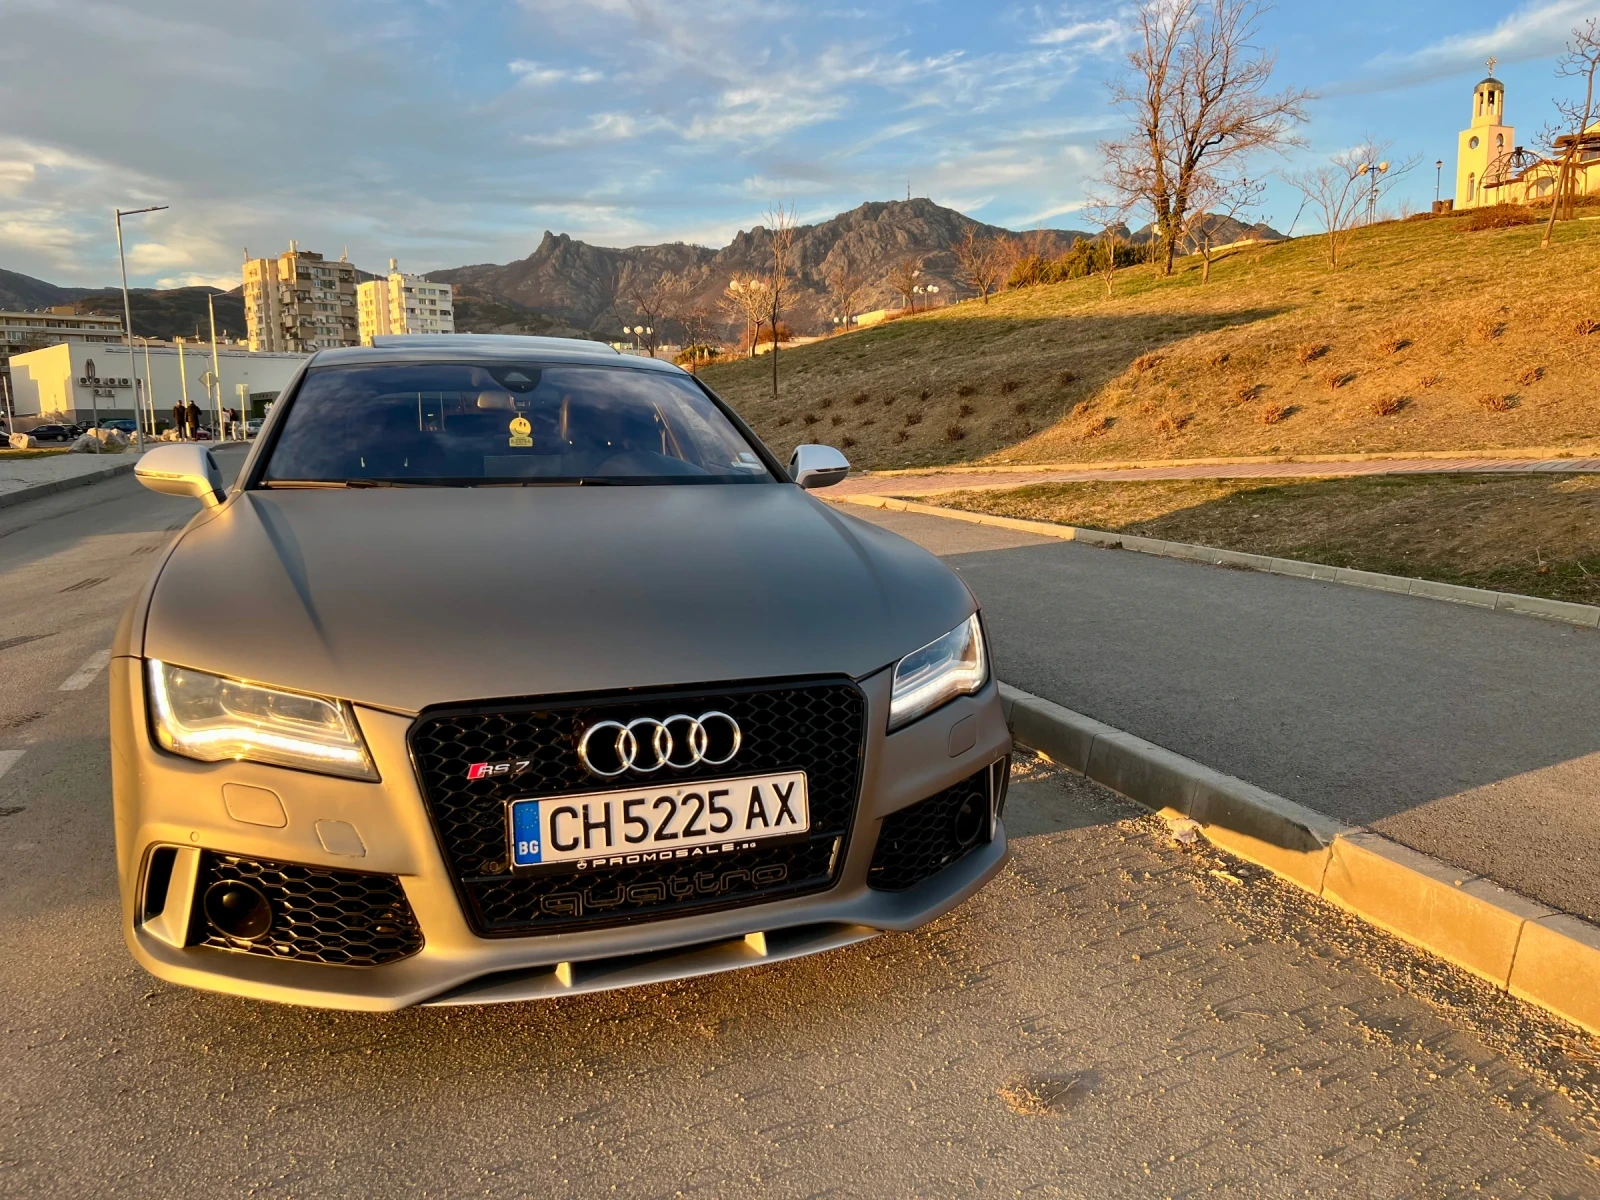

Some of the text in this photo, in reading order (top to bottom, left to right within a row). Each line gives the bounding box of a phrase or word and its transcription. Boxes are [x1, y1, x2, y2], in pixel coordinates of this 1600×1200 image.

[478, 763, 511, 776] RS
[745, 781, 797, 830] AX
[519, 840, 539, 855] BG
[540, 863, 788, 917] quattro
